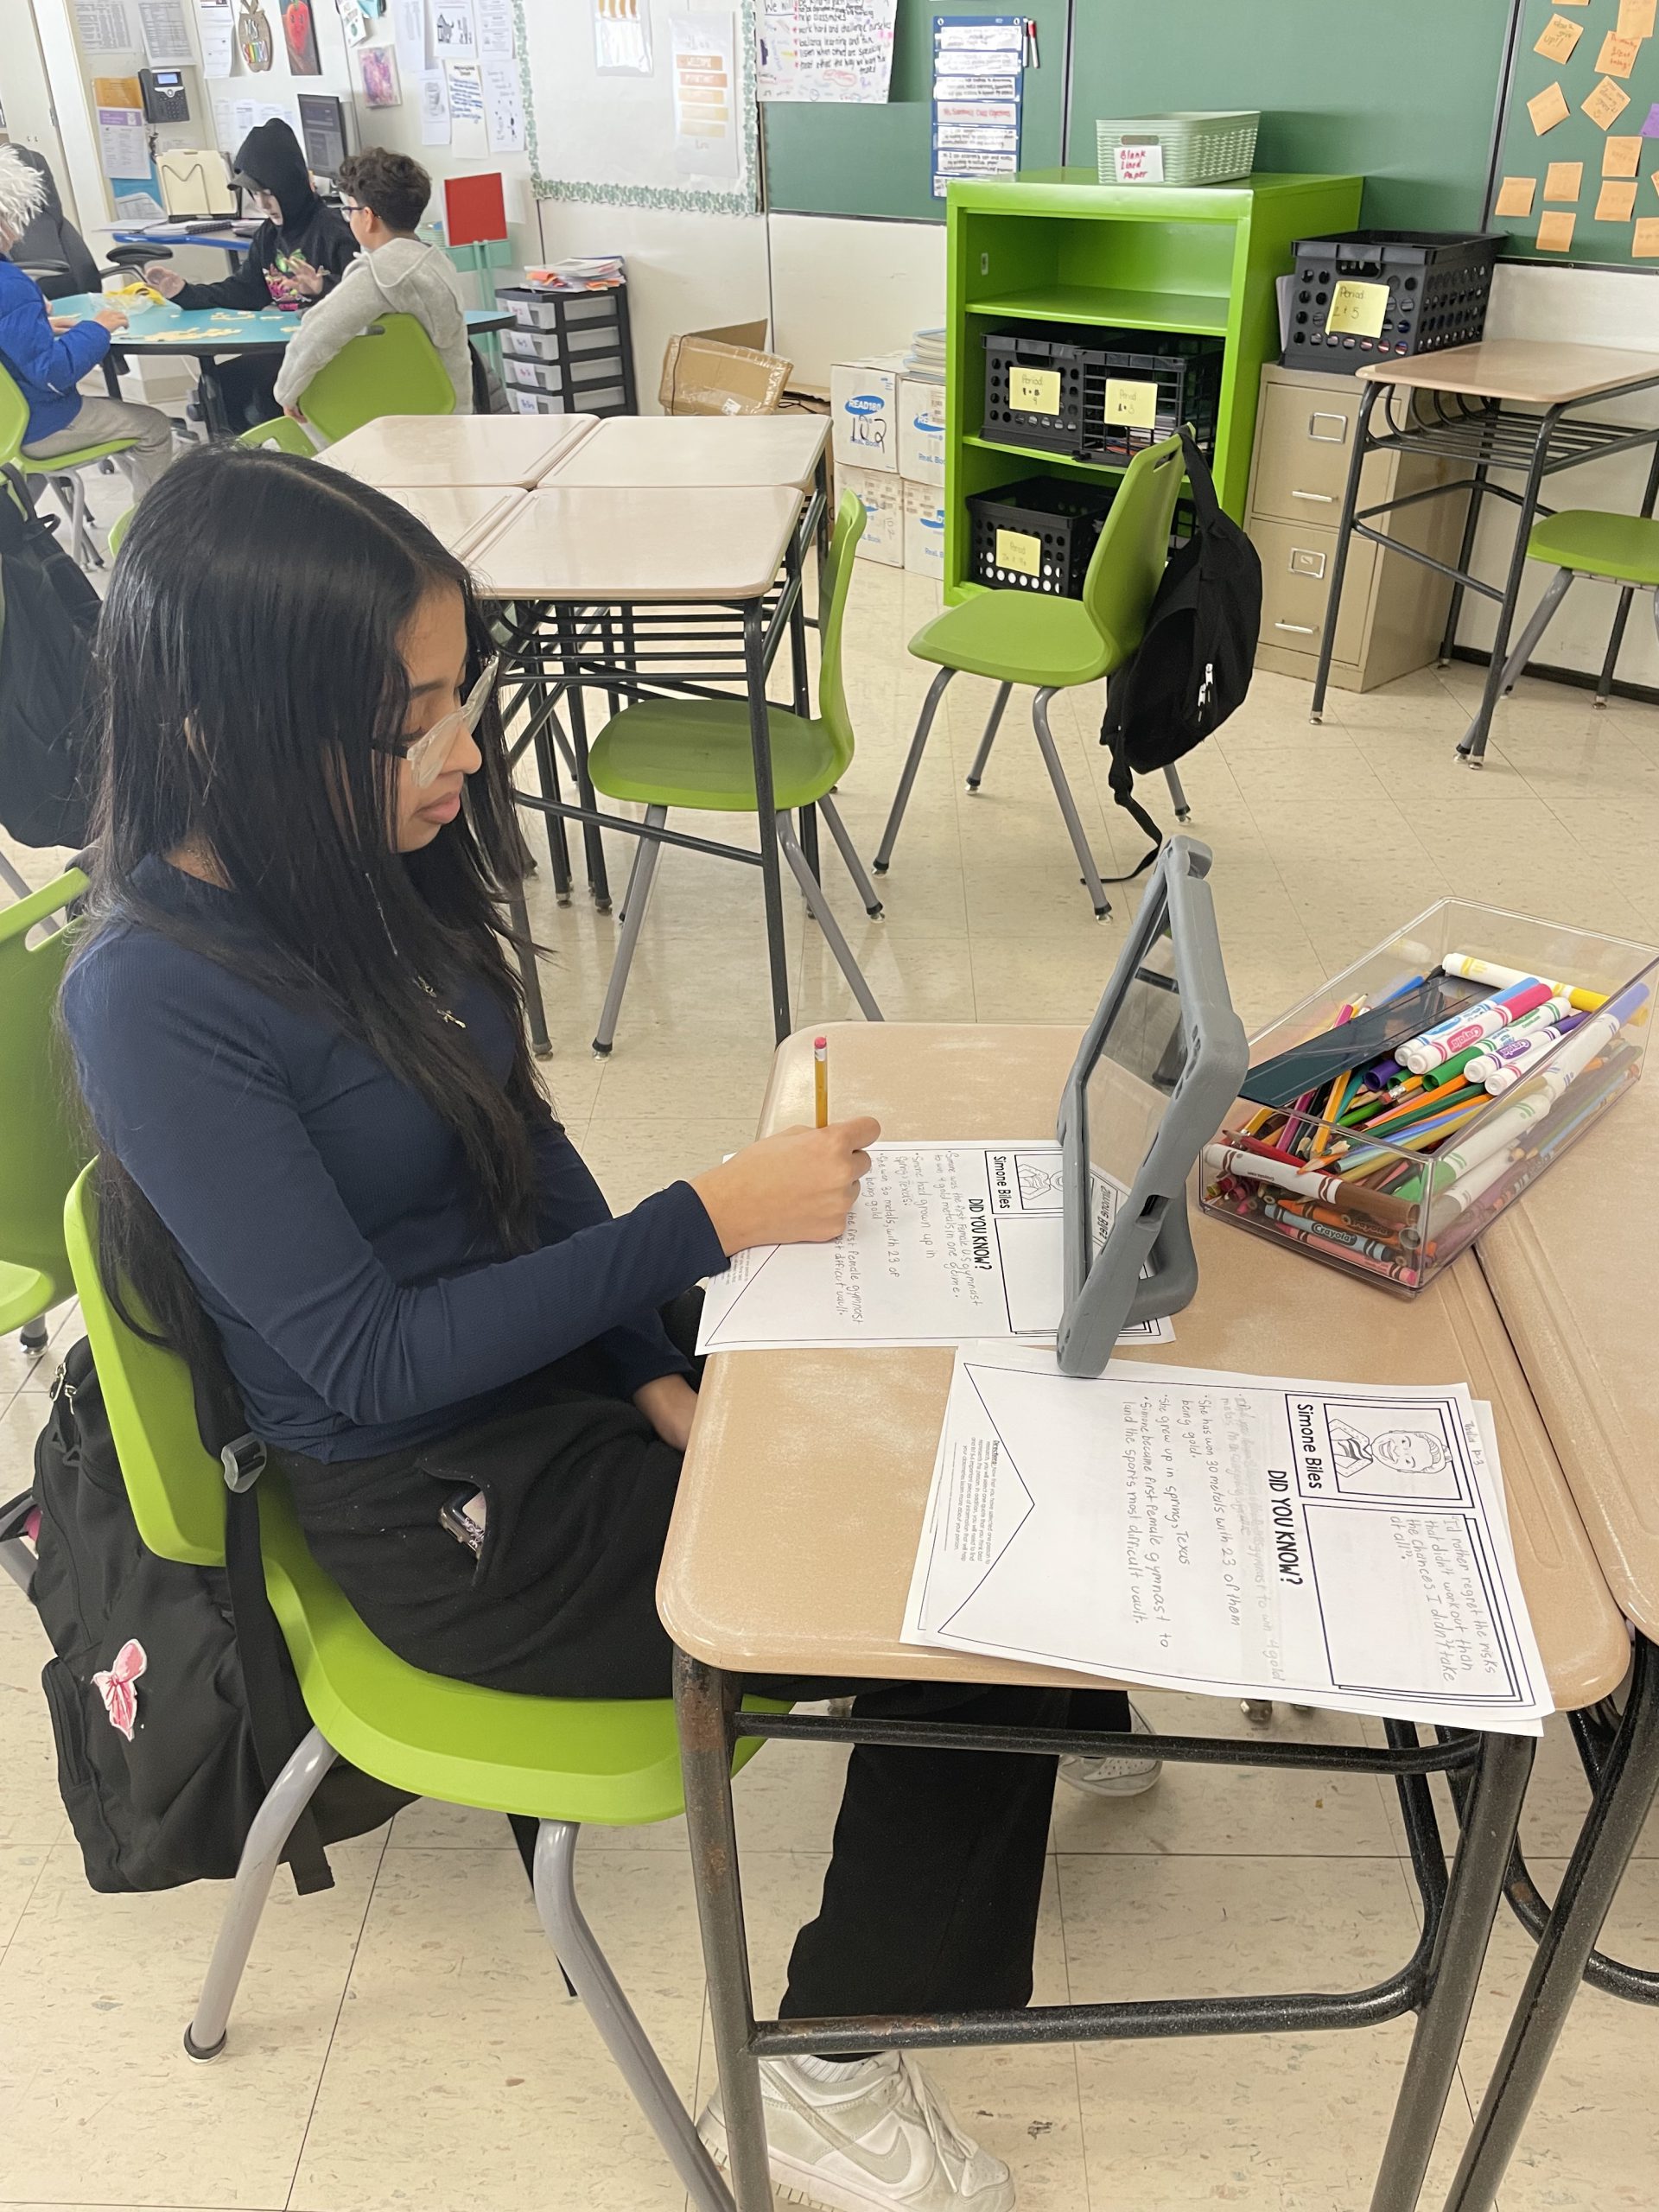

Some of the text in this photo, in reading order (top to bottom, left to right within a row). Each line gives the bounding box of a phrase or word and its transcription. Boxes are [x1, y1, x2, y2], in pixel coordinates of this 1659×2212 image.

[1450, 1026, 1482, 1050] Crayola
[1501, 1039, 1529, 1057] Crayola
[994, 1155, 1012, 1209] Simone Biles
[918, 1233, 933, 1246] up
[926, 1250, 937, 1259] in
[968, 1198, 993, 1270] DID YOU KNOW?
[1313, 1224, 1353, 1243] Crayola
[887, 1251, 900, 1262] 23
[1122, 1401, 1137, 1422] land
[1141, 1402, 1151, 1432] Simone
[1177, 1400, 1194, 1426] being
[1198, 1400, 1211, 1415] She
[1125, 1427, 1141, 1444] the
[1202, 1419, 1214, 1435] has
[991, 1440, 1001, 1467] Directions:
[1141, 1434, 1158, 1472] became
[1205, 1438, 1215, 1456] won
[1297, 1403, 1324, 1490] Simone Biles
[1123, 1448, 1140, 1487] sports
[1206, 1460, 1218, 1473] 30
[1158, 1399, 1191, 1566] She grew up in Texas
[1210, 1476, 1227, 1514] metals
[1128, 1492, 1142, 1520] most
[1215, 1517, 1235, 1542] with
[1268, 1470, 1303, 1585] DID YOU KNOW?
[1390, 1516, 1407, 1529] at
[1424, 1521, 1445, 1541] that
[1126, 1524, 1147, 1578] difficult
[1221, 1548, 1236, 1567] 23
[1144, 1552, 1172, 1623] gymnast
[1224, 1574, 1241, 1592] of
[1406, 1519, 1422, 1535] the
[1426, 1595, 1442, 1604] I
[1440, 1651, 1459, 1681] take
[1452, 1538, 1498, 1674] rather regret the risks
[1450, 1611, 1469, 1633] out
[1160, 1632, 1172, 1649] to
[1262, 1649, 1287, 1681] gold
[1455, 1638, 1473, 1671] than
